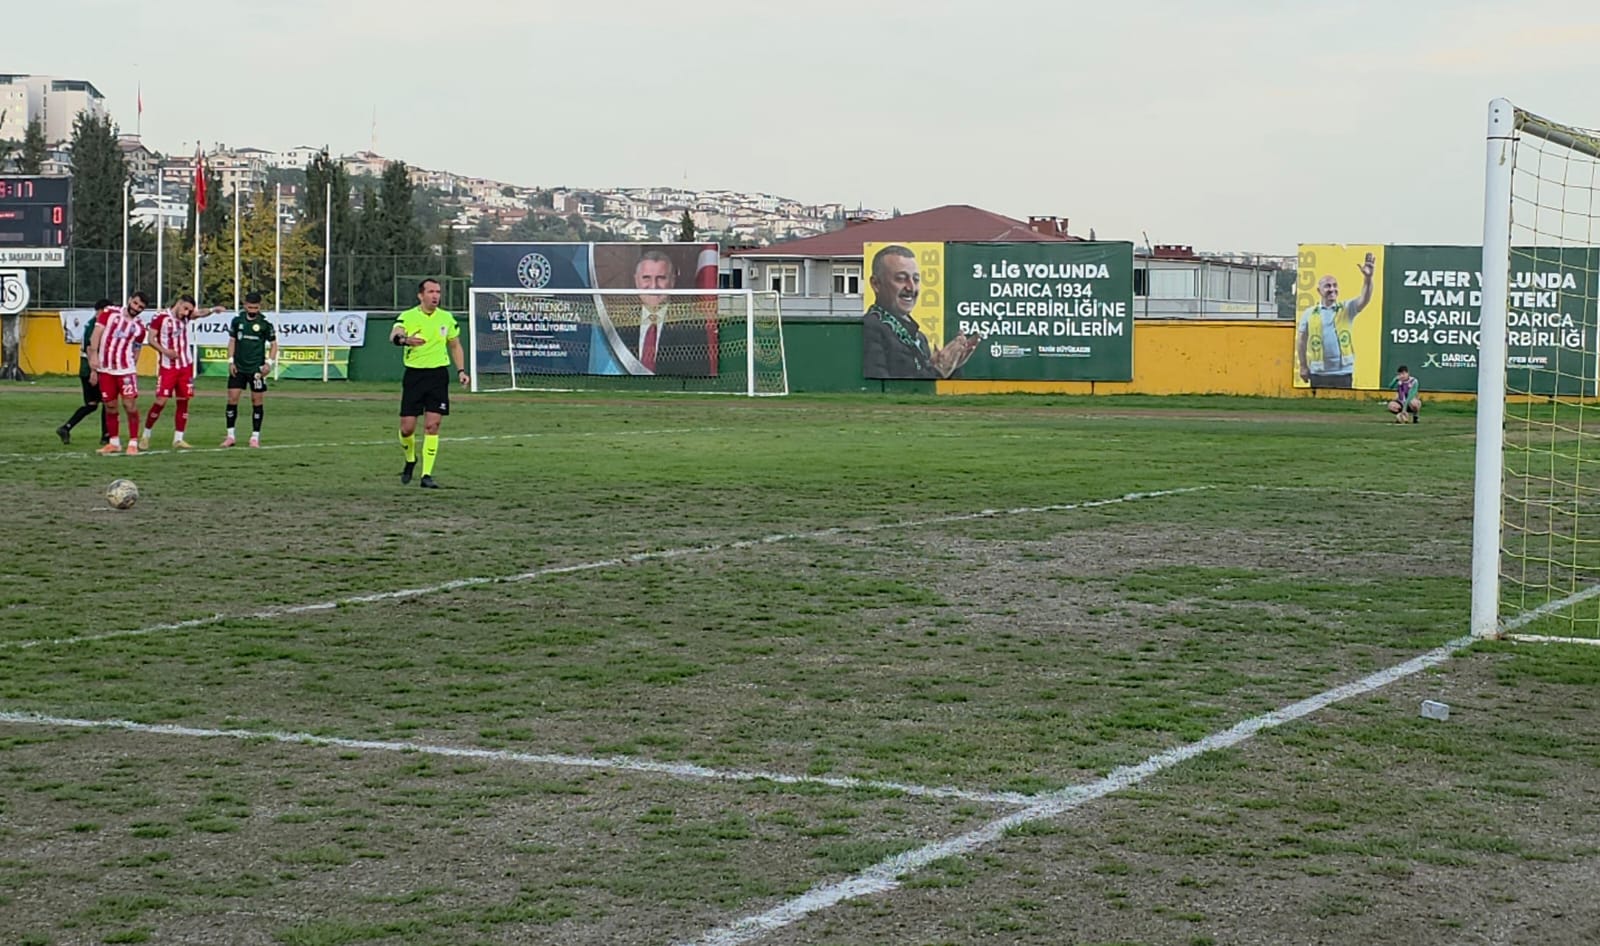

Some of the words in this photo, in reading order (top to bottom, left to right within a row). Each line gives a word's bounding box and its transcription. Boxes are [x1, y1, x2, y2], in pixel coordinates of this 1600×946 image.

[53, 207, 62, 224] 0
[972, 264, 987, 279] 3.
[991, 260, 1021, 279] LİG
[1024, 264, 1110, 279] YOLUNDA
[921, 249, 940, 308] DGB
[1404, 271, 1470, 288] ZAFER
[990, 283, 1053, 298] DARICA
[1056, 283, 1093, 298] 1934
[1421, 290, 1464, 306] TAM
[1469, 291, 1557, 308] DTEK!
[488, 312, 501, 321] VE
[1507, 312, 1574, 328] DARICA
[959, 320, 1050, 339] BAŞARILAR
[1053, 318, 1123, 337] DİLERİM
[1391, 329, 1429, 344] 1934
[1441, 353, 1477, 362] DARICA
[122, 384, 133, 395] 22
